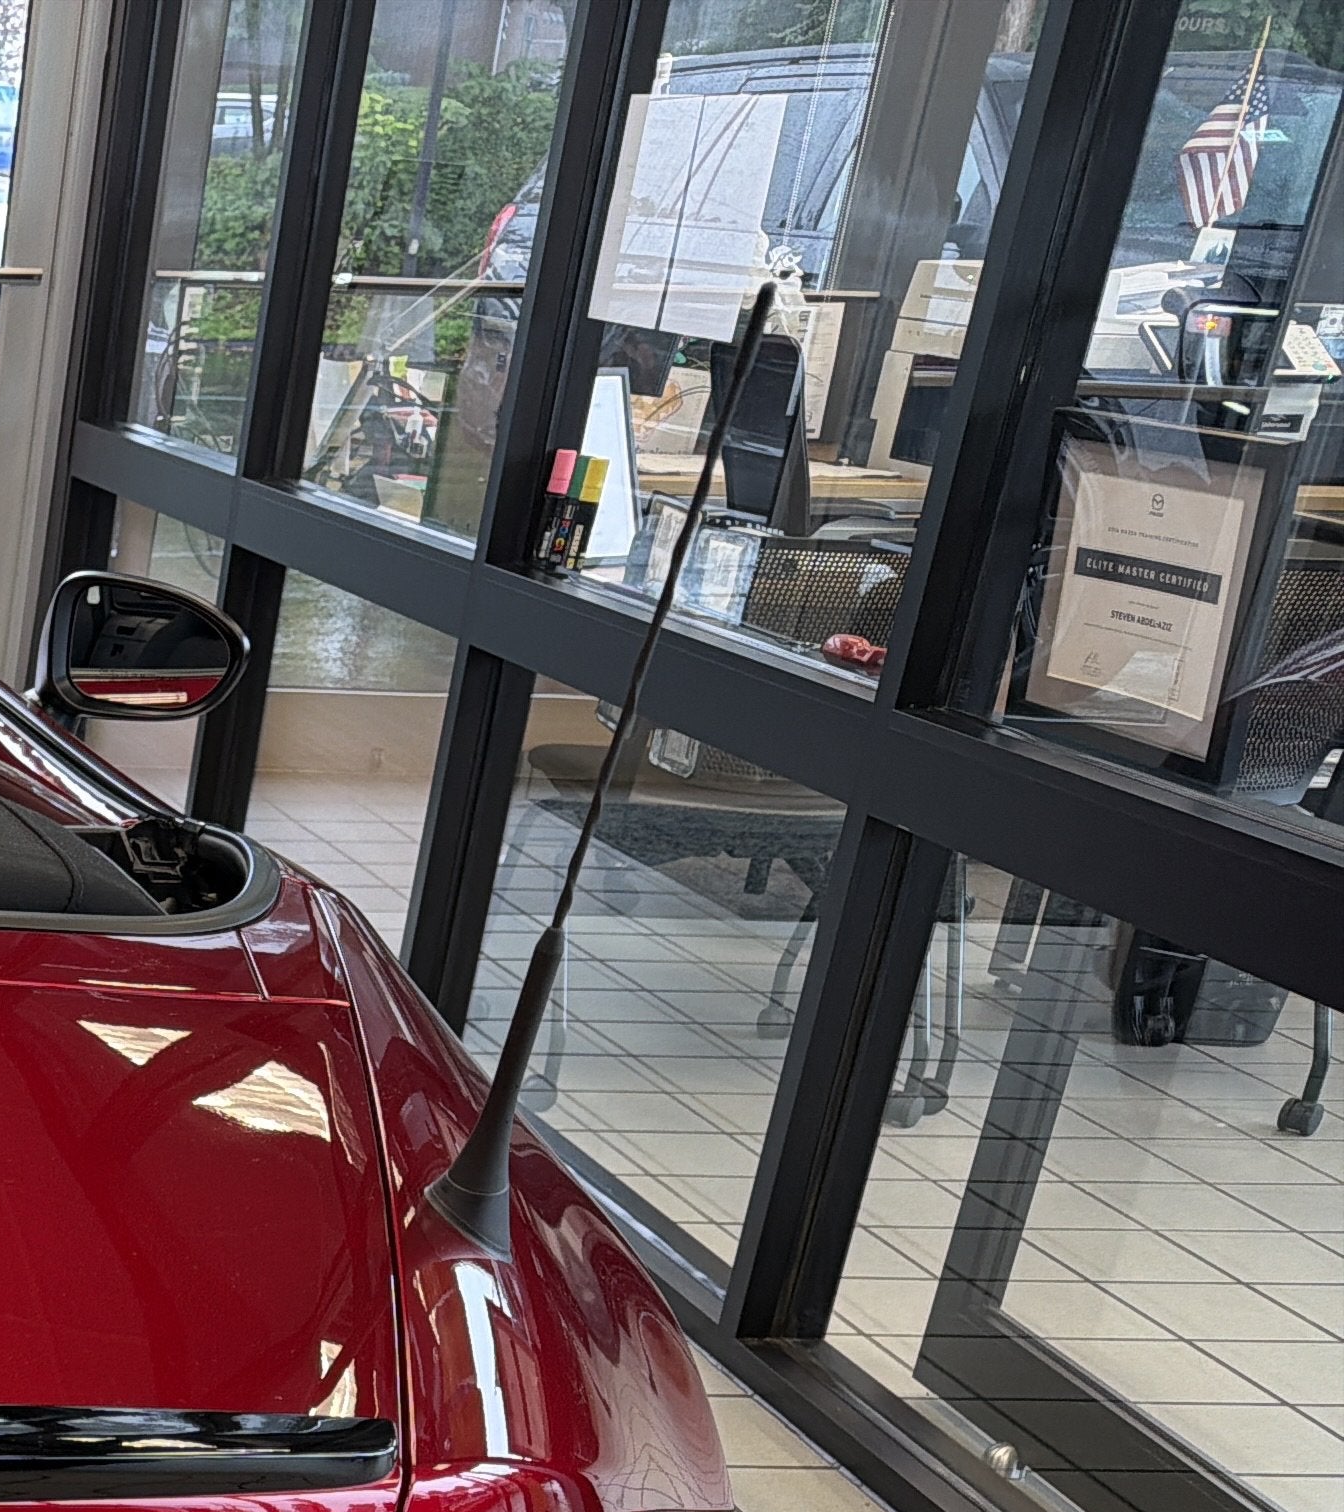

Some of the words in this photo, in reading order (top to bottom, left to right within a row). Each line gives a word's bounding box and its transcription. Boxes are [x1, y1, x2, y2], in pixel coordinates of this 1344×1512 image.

[1086, 557, 1113, 572] ELITE
[1118, 563, 1155, 580] MASTER
[1160, 573, 1209, 592] CERTIFIED
[1110, 609, 1136, 624] STEVEN
